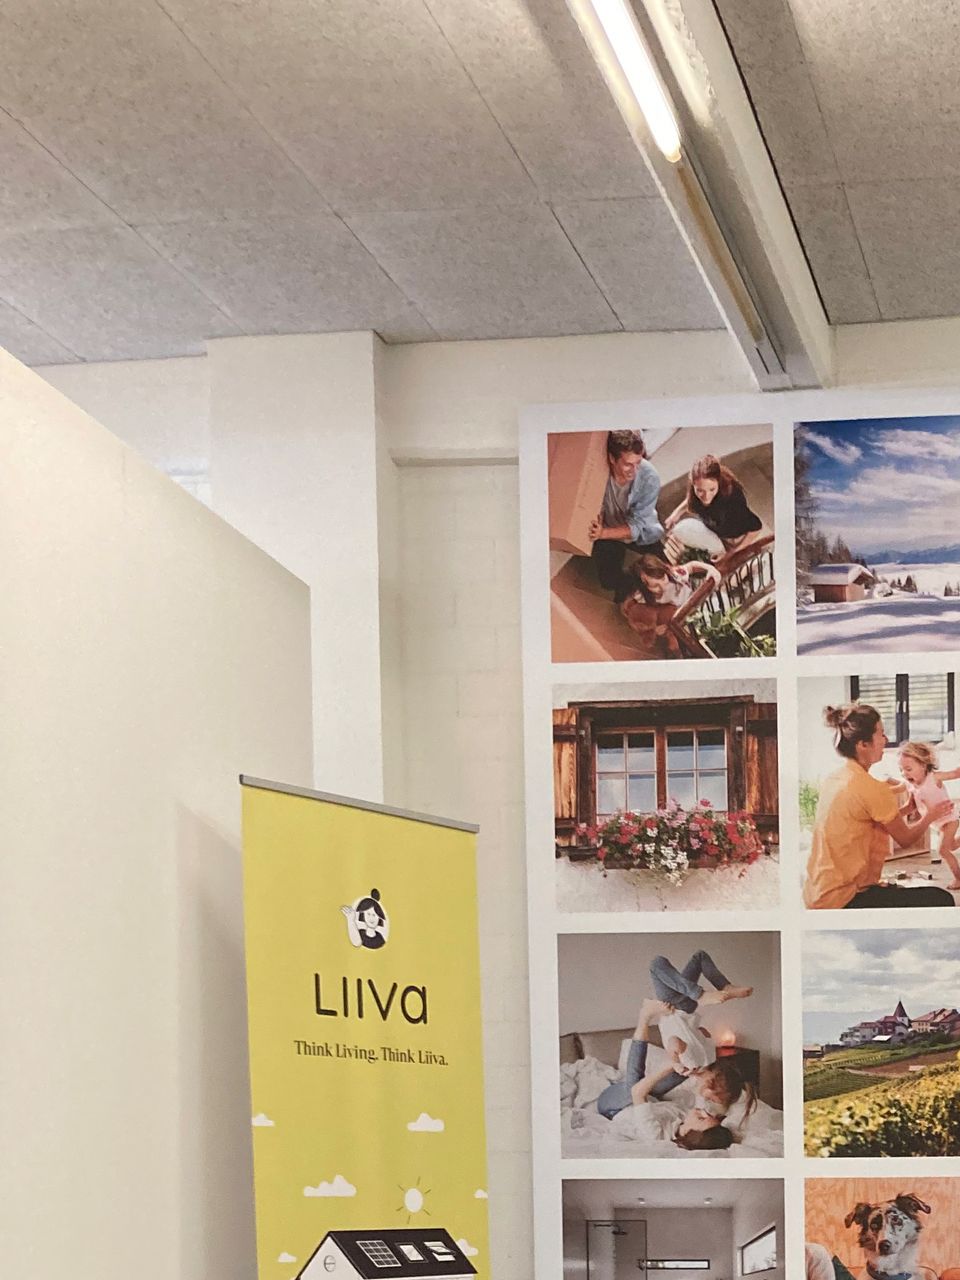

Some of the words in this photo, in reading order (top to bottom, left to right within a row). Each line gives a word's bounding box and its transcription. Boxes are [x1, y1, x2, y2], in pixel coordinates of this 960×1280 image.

[294, 1040, 333, 1058] Think
[335, 1043, 379, 1064] Living.
[380, 1046, 416, 1064] Think
[418, 1050, 449, 1066] Liiva.
